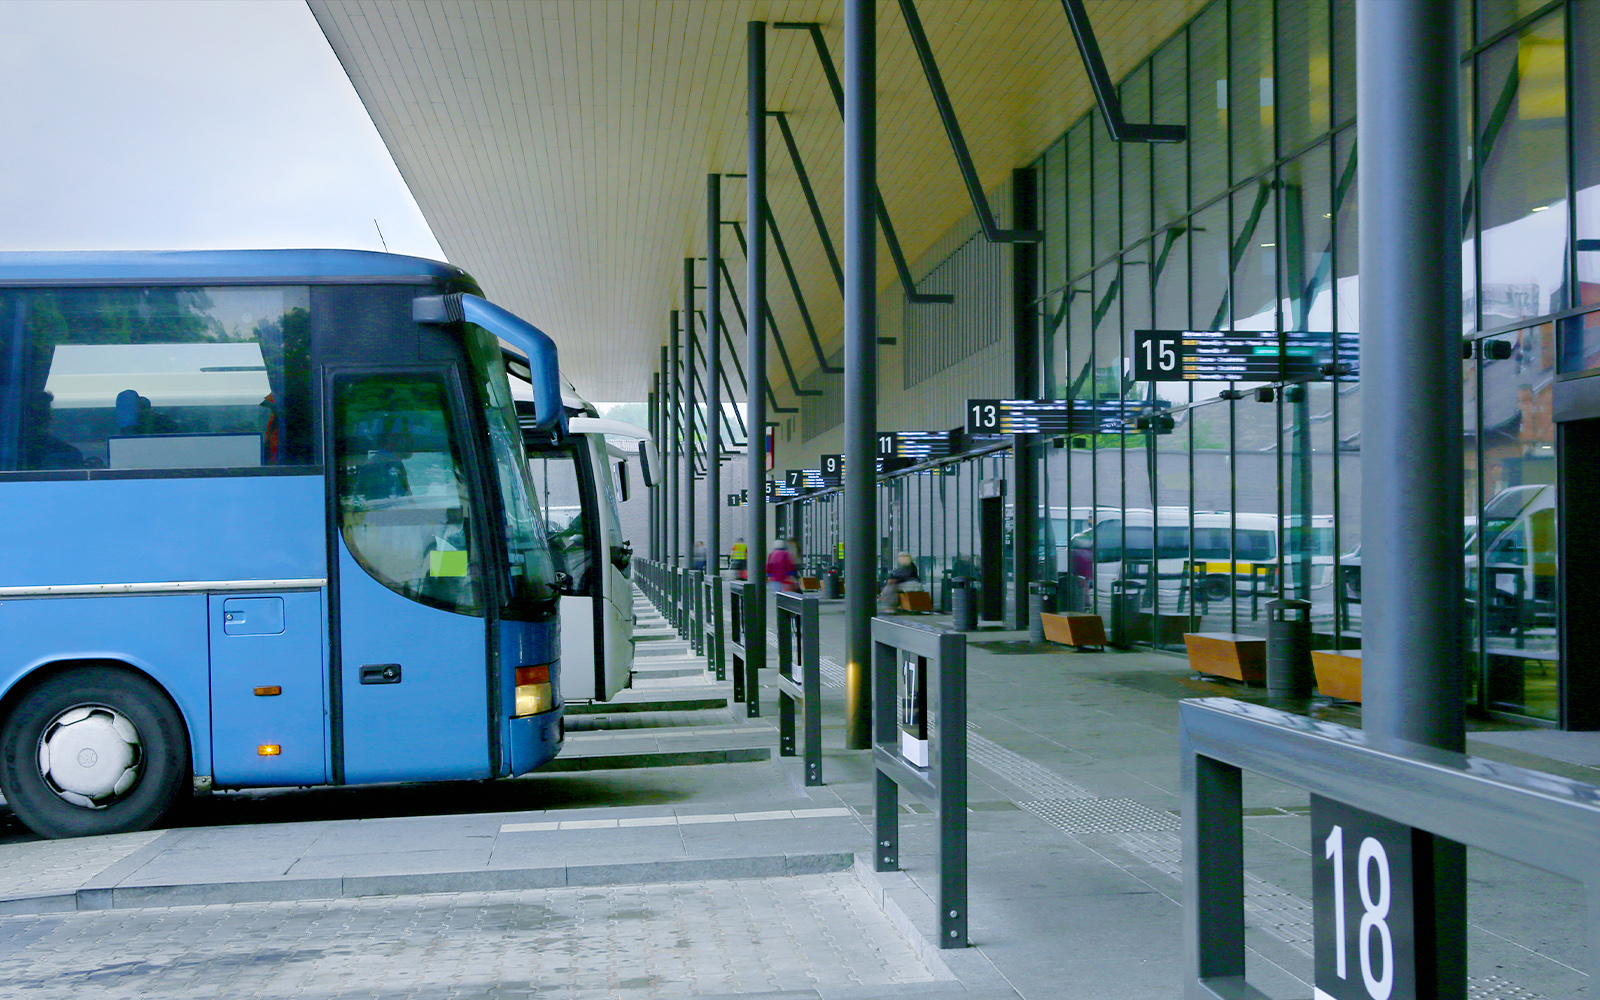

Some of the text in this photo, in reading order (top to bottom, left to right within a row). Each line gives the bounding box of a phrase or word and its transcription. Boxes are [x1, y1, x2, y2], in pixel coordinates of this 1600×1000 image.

[1142, 339, 1175, 371] 15
[972, 405, 996, 428] 13
[879, 436, 892, 453] 11
[827, 458, 836, 472] 9
[766, 483, 771, 493] 5
[791, 473, 798, 485] 7
[904, 660, 916, 726] 17
[1325, 825, 1394, 1000] 18
